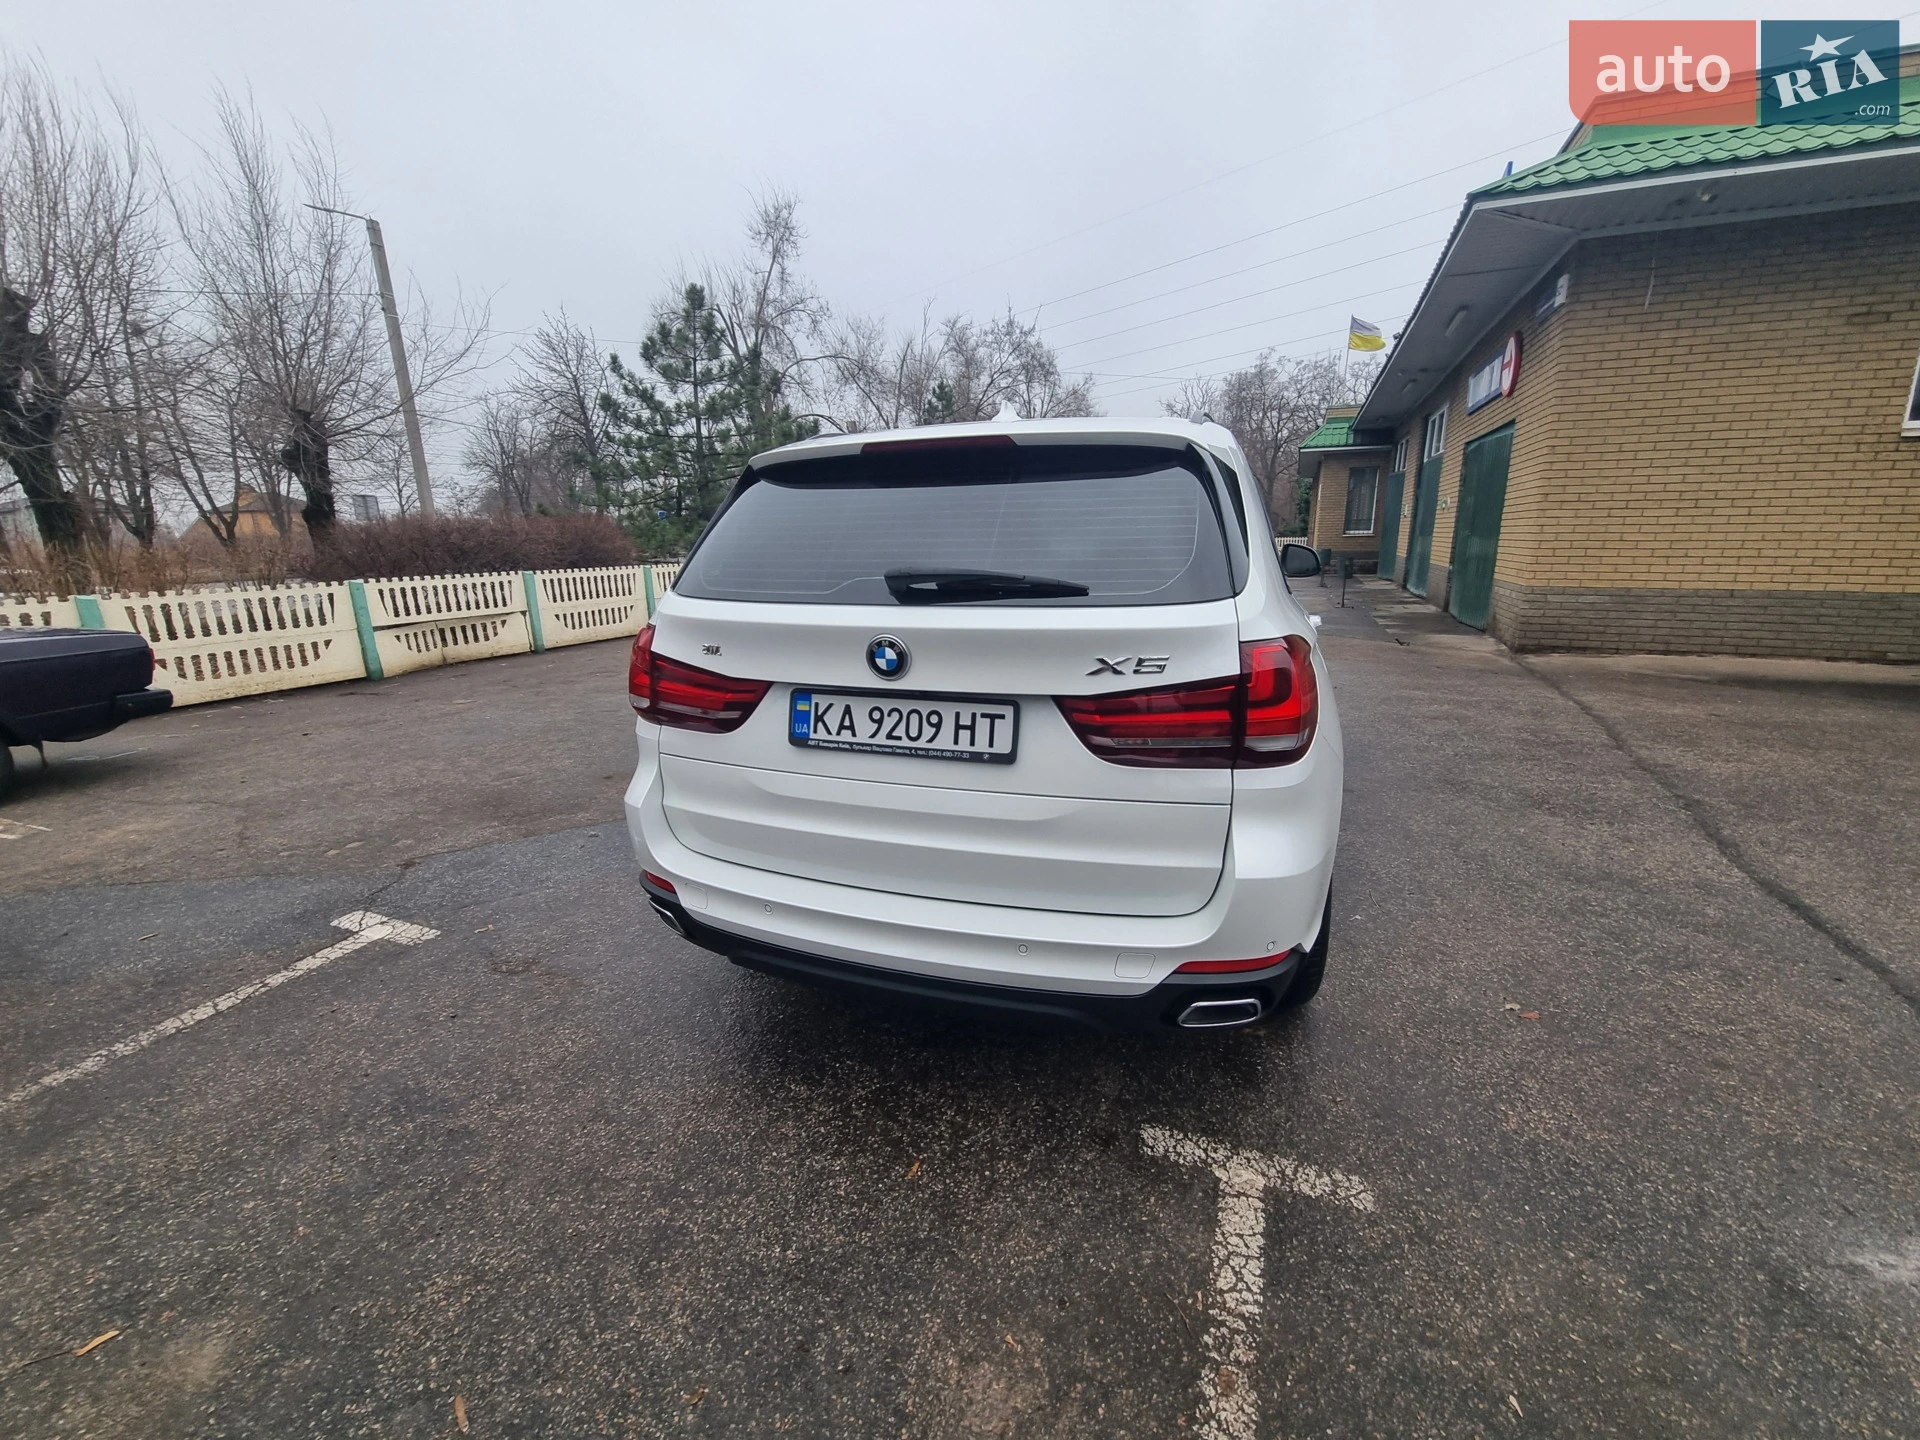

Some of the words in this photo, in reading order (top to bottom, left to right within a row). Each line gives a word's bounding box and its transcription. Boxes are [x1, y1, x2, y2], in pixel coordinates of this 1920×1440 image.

[1084, 655, 1170, 676] X5
[795, 723, 809, 734] UA
[813, 701, 857, 738] KA
[867, 705, 943, 744] 9209
[953, 711, 1006, 748] HT
[942, 751, 970, 759] 490-77-33
